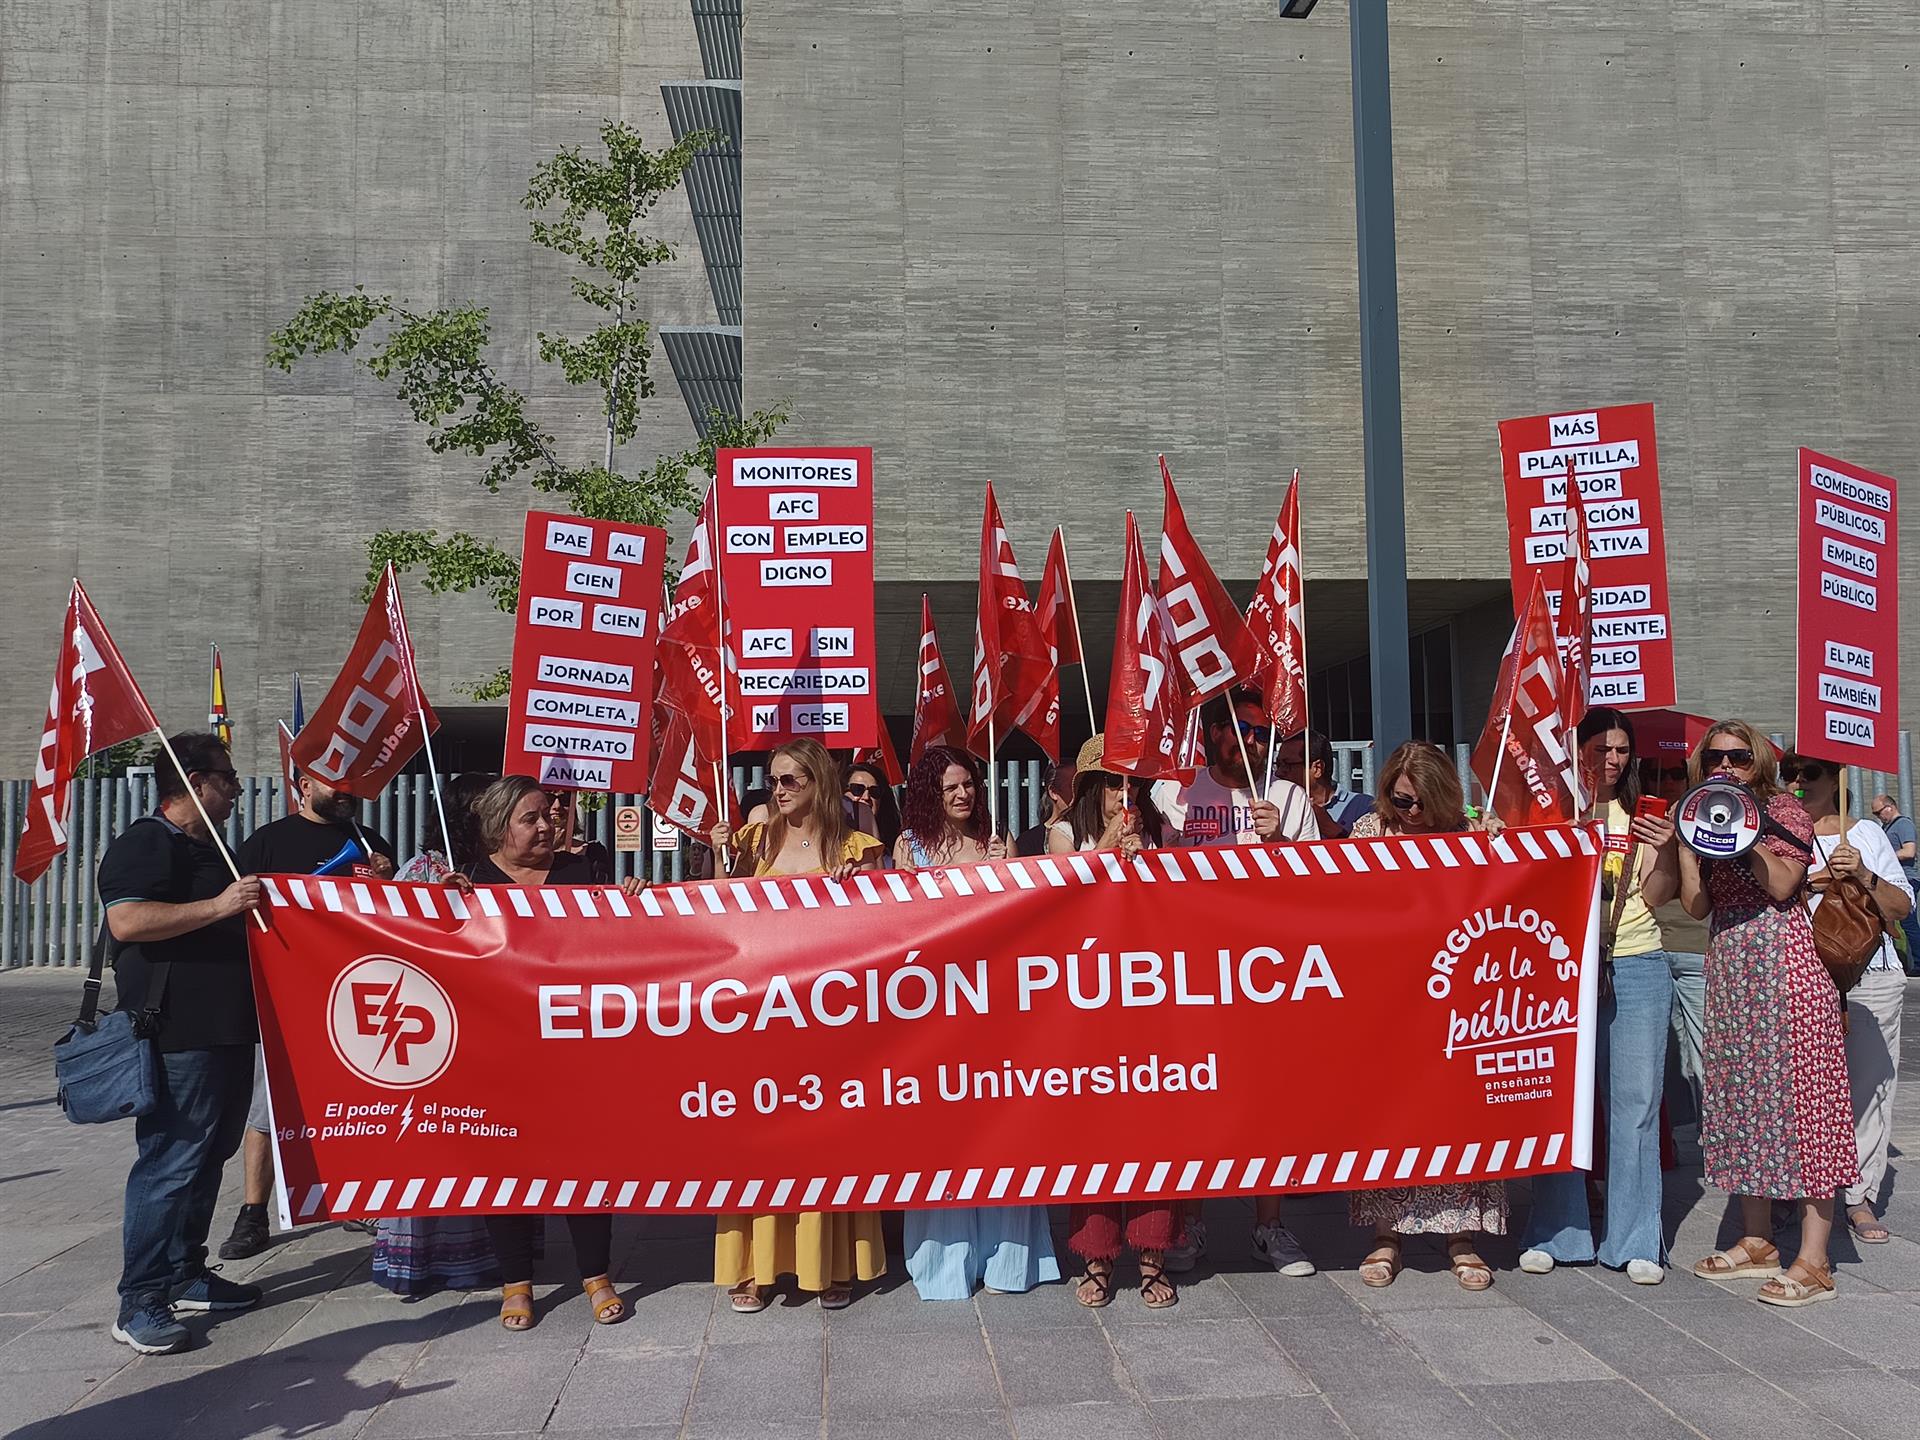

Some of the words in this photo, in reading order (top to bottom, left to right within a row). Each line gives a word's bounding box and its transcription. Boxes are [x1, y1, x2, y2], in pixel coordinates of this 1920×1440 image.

[1553, 419, 1595, 438] MÁS
[740, 466, 852, 480] MONITORES
[1551, 478, 1616, 496] MJOR
[1815, 472, 1889, 509] COMEDORES
[776, 500, 814, 514] AFC
[1538, 505, 1634, 527] ATCIÓN
[1821, 504, 1882, 538] PÚBLICOS,
[553, 532, 588, 549] PAE
[614, 543, 636, 557] AL
[730, 532, 771, 546] CON
[787, 531, 864, 546] EMPLEO
[1827, 544, 1875, 572] EMPLEO
[573, 572, 614, 589] CIEN
[765, 565, 827, 580] DIGNO
[1823, 572, 1874, 606] PÚBLICO
[536, 607, 574, 623] POR
[600, 612, 640, 628] CIEN
[749, 637, 786, 651] AFC
[817, 636, 848, 650] SIN
[1830, 647, 1845, 663] EL
[1847, 650, 1870, 669] PAE
[544, 664, 630, 685] JORNADA
[1591, 681, 1637, 698] ABLE
[1824, 682, 1876, 707] TAMBIÉN
[756, 712, 774, 725] NI
[797, 712, 844, 726] CESE
[1829, 719, 1871, 739] EDUCA
[531, 734, 627, 754] CONTRATO
[546, 766, 607, 783] ANUAL
[1185, 822, 1218, 831] CCOO
[1473, 952, 1503, 985] de
[1509, 946, 1536, 980] la
[538, 950, 989, 1040] EDUCACIÓN
[1017, 937, 1344, 1012] PÚBLICA
[1445, 986, 1578, 1060] pública
[1475, 1046, 1555, 1076] CCOO
[680, 1081, 737, 1119] de
[753, 1073, 824, 1115] 0-3
[840, 1078, 865, 1109] a
[882, 1067, 922, 1107] la
[938, 1053, 1218, 1102] Universidad
[1485, 1073, 1552, 1090] enseñanza
[1486, 1088, 1552, 1105] Extremadura
[324, 1102, 343, 1117] El
[346, 1101, 398, 1120] poder
[423, 1102, 437, 1115] el
[441, 1104, 486, 1119] poder
[301, 1124, 317, 1139] lo
[320, 1121, 387, 1141] público
[417, 1119, 437, 1133] de
[442, 1120, 455, 1134] la
[459, 1121, 518, 1138] Pública
